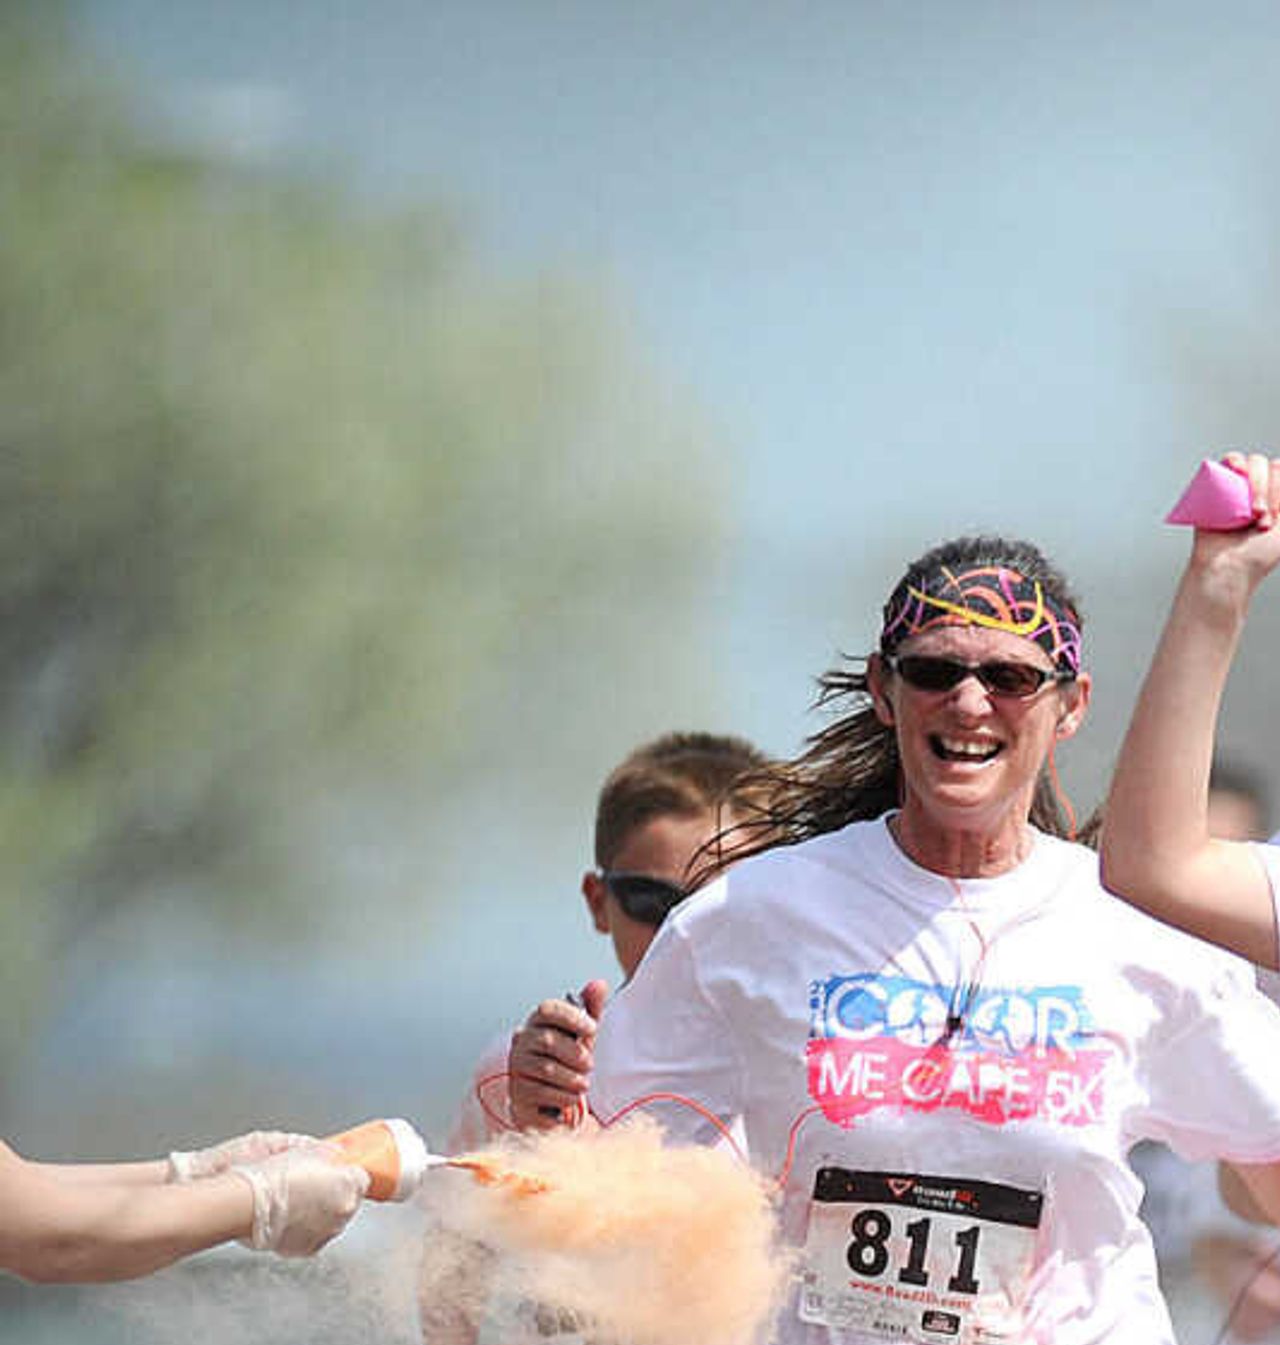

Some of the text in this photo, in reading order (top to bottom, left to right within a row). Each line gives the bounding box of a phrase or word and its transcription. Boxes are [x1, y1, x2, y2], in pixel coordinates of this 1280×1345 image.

[817, 1051, 1099, 1118] ME CAPE 5K
[847, 1209, 981, 1296] 811
